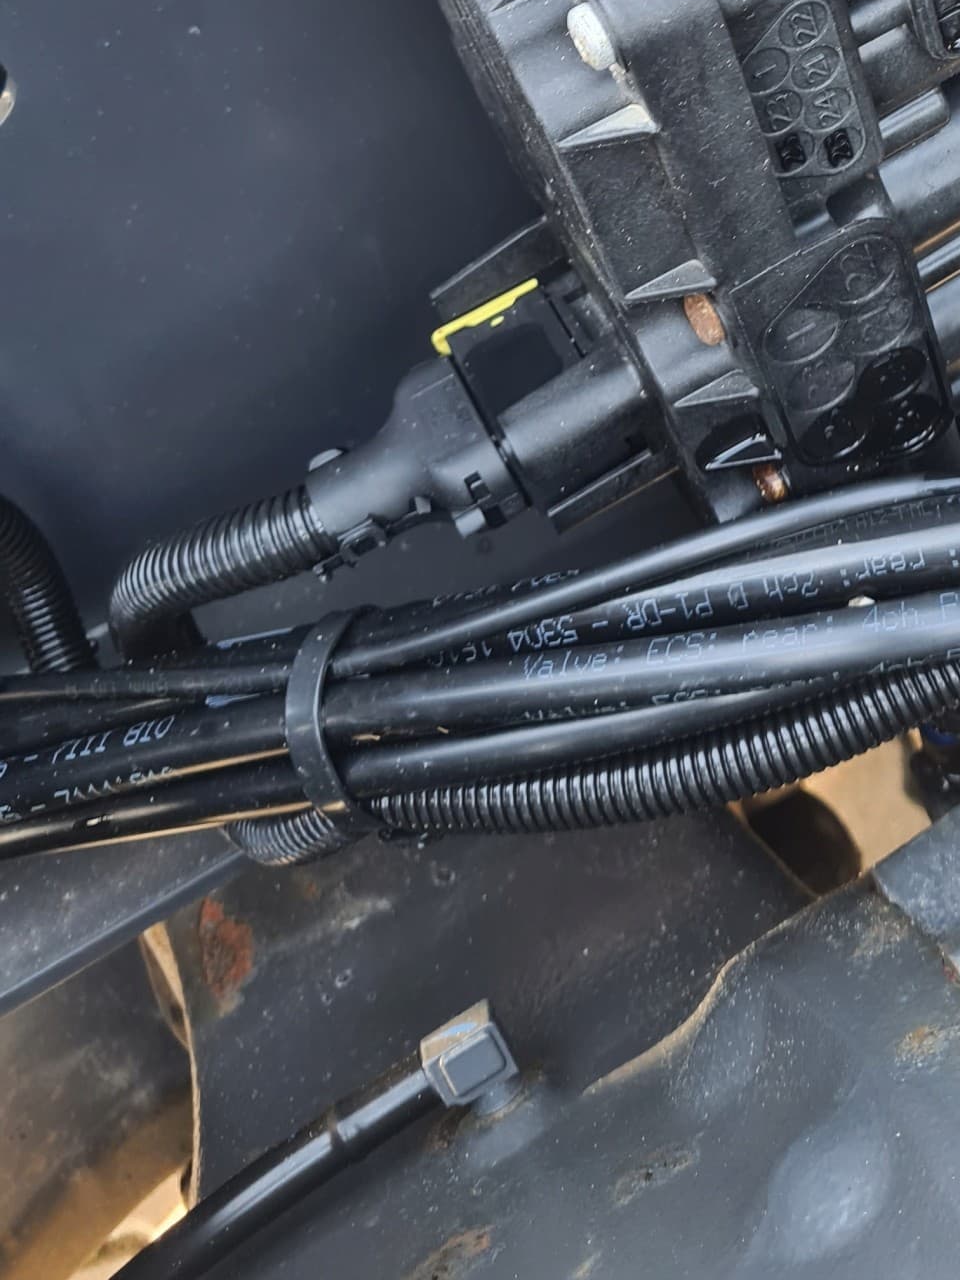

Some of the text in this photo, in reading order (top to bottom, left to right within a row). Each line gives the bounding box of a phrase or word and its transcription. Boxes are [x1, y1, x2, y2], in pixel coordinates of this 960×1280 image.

[790, 5, 819, 45] 22
[752, 64, 777, 80] 1
[801, 53, 830, 85] 21
[836, 546, 928, 593] rear:
